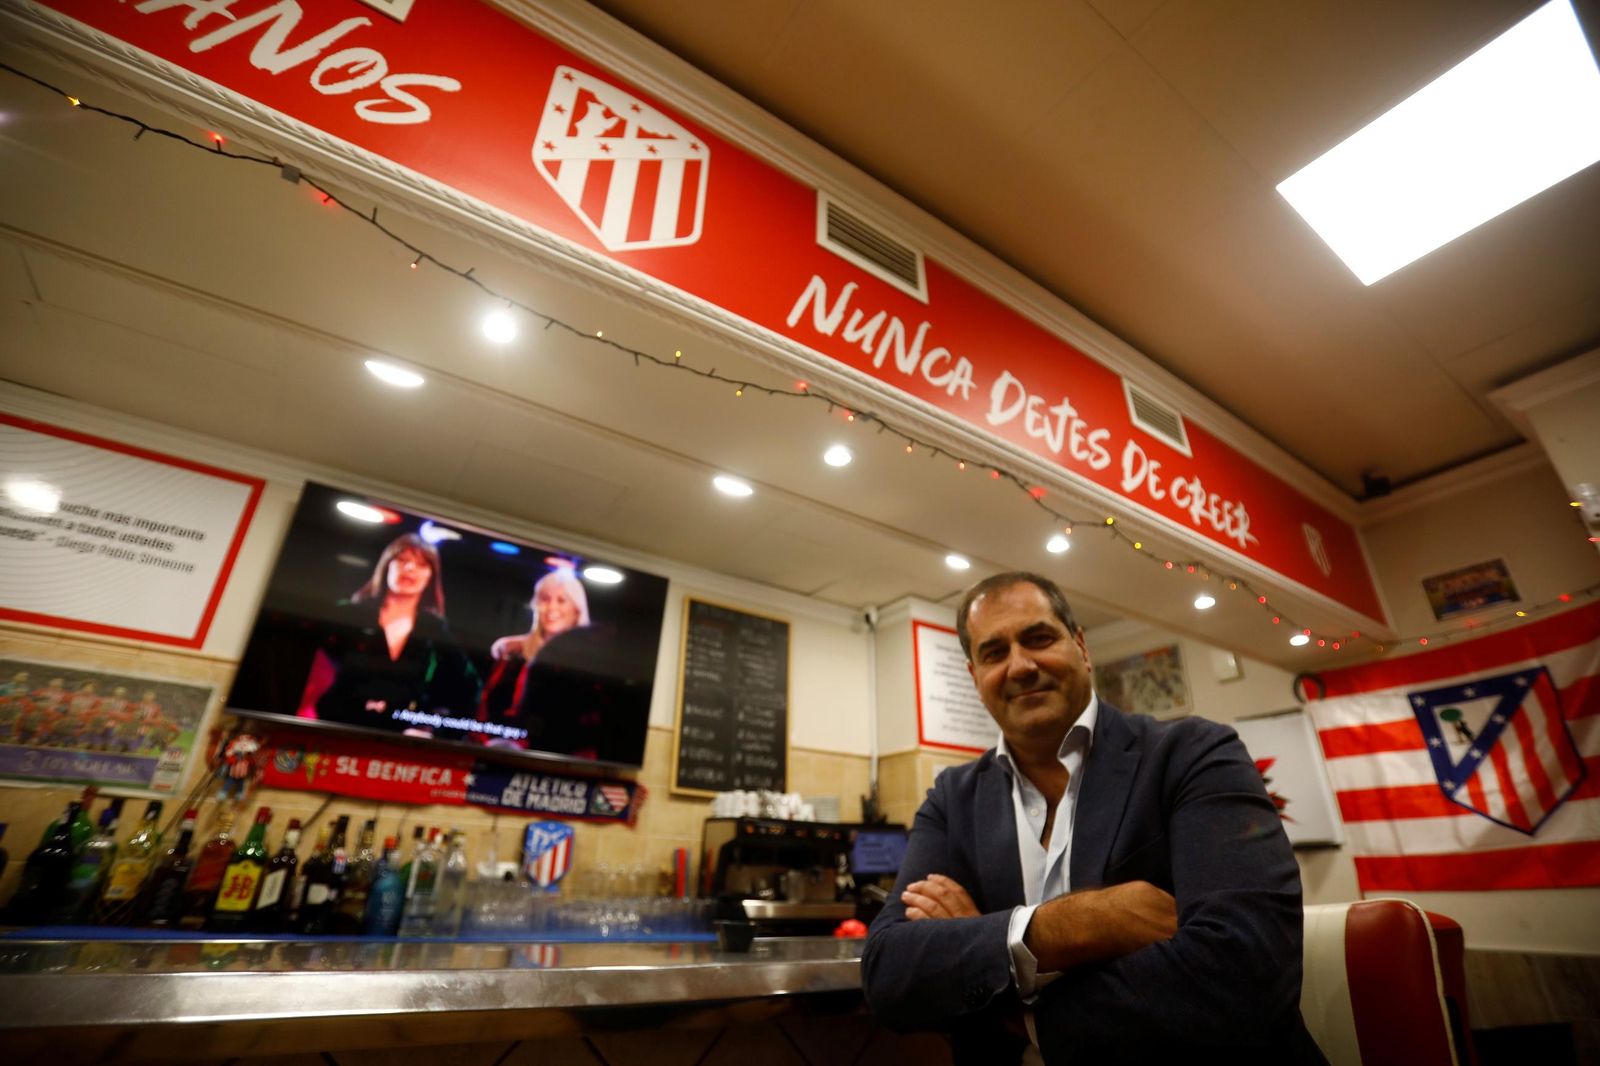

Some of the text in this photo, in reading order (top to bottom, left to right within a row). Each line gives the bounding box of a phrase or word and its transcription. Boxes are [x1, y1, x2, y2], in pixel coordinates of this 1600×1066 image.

[986, 370, 1111, 470] DEJES
[1121, 440, 1165, 500] DE
[1170, 476, 1261, 548] CREER
[77, 523, 116, 539] todos
[119, 533, 175, 552] ustedes
[132, 517, 206, 541] importante
[56, 535, 96, 554] Diego
[98, 544, 135, 562] Pablo
[139, 552, 195, 573] Simeone
[335, 755, 452, 786] SL BENFICA
[501, 785, 525, 808] DE
[525, 793, 587, 815] MADRID
